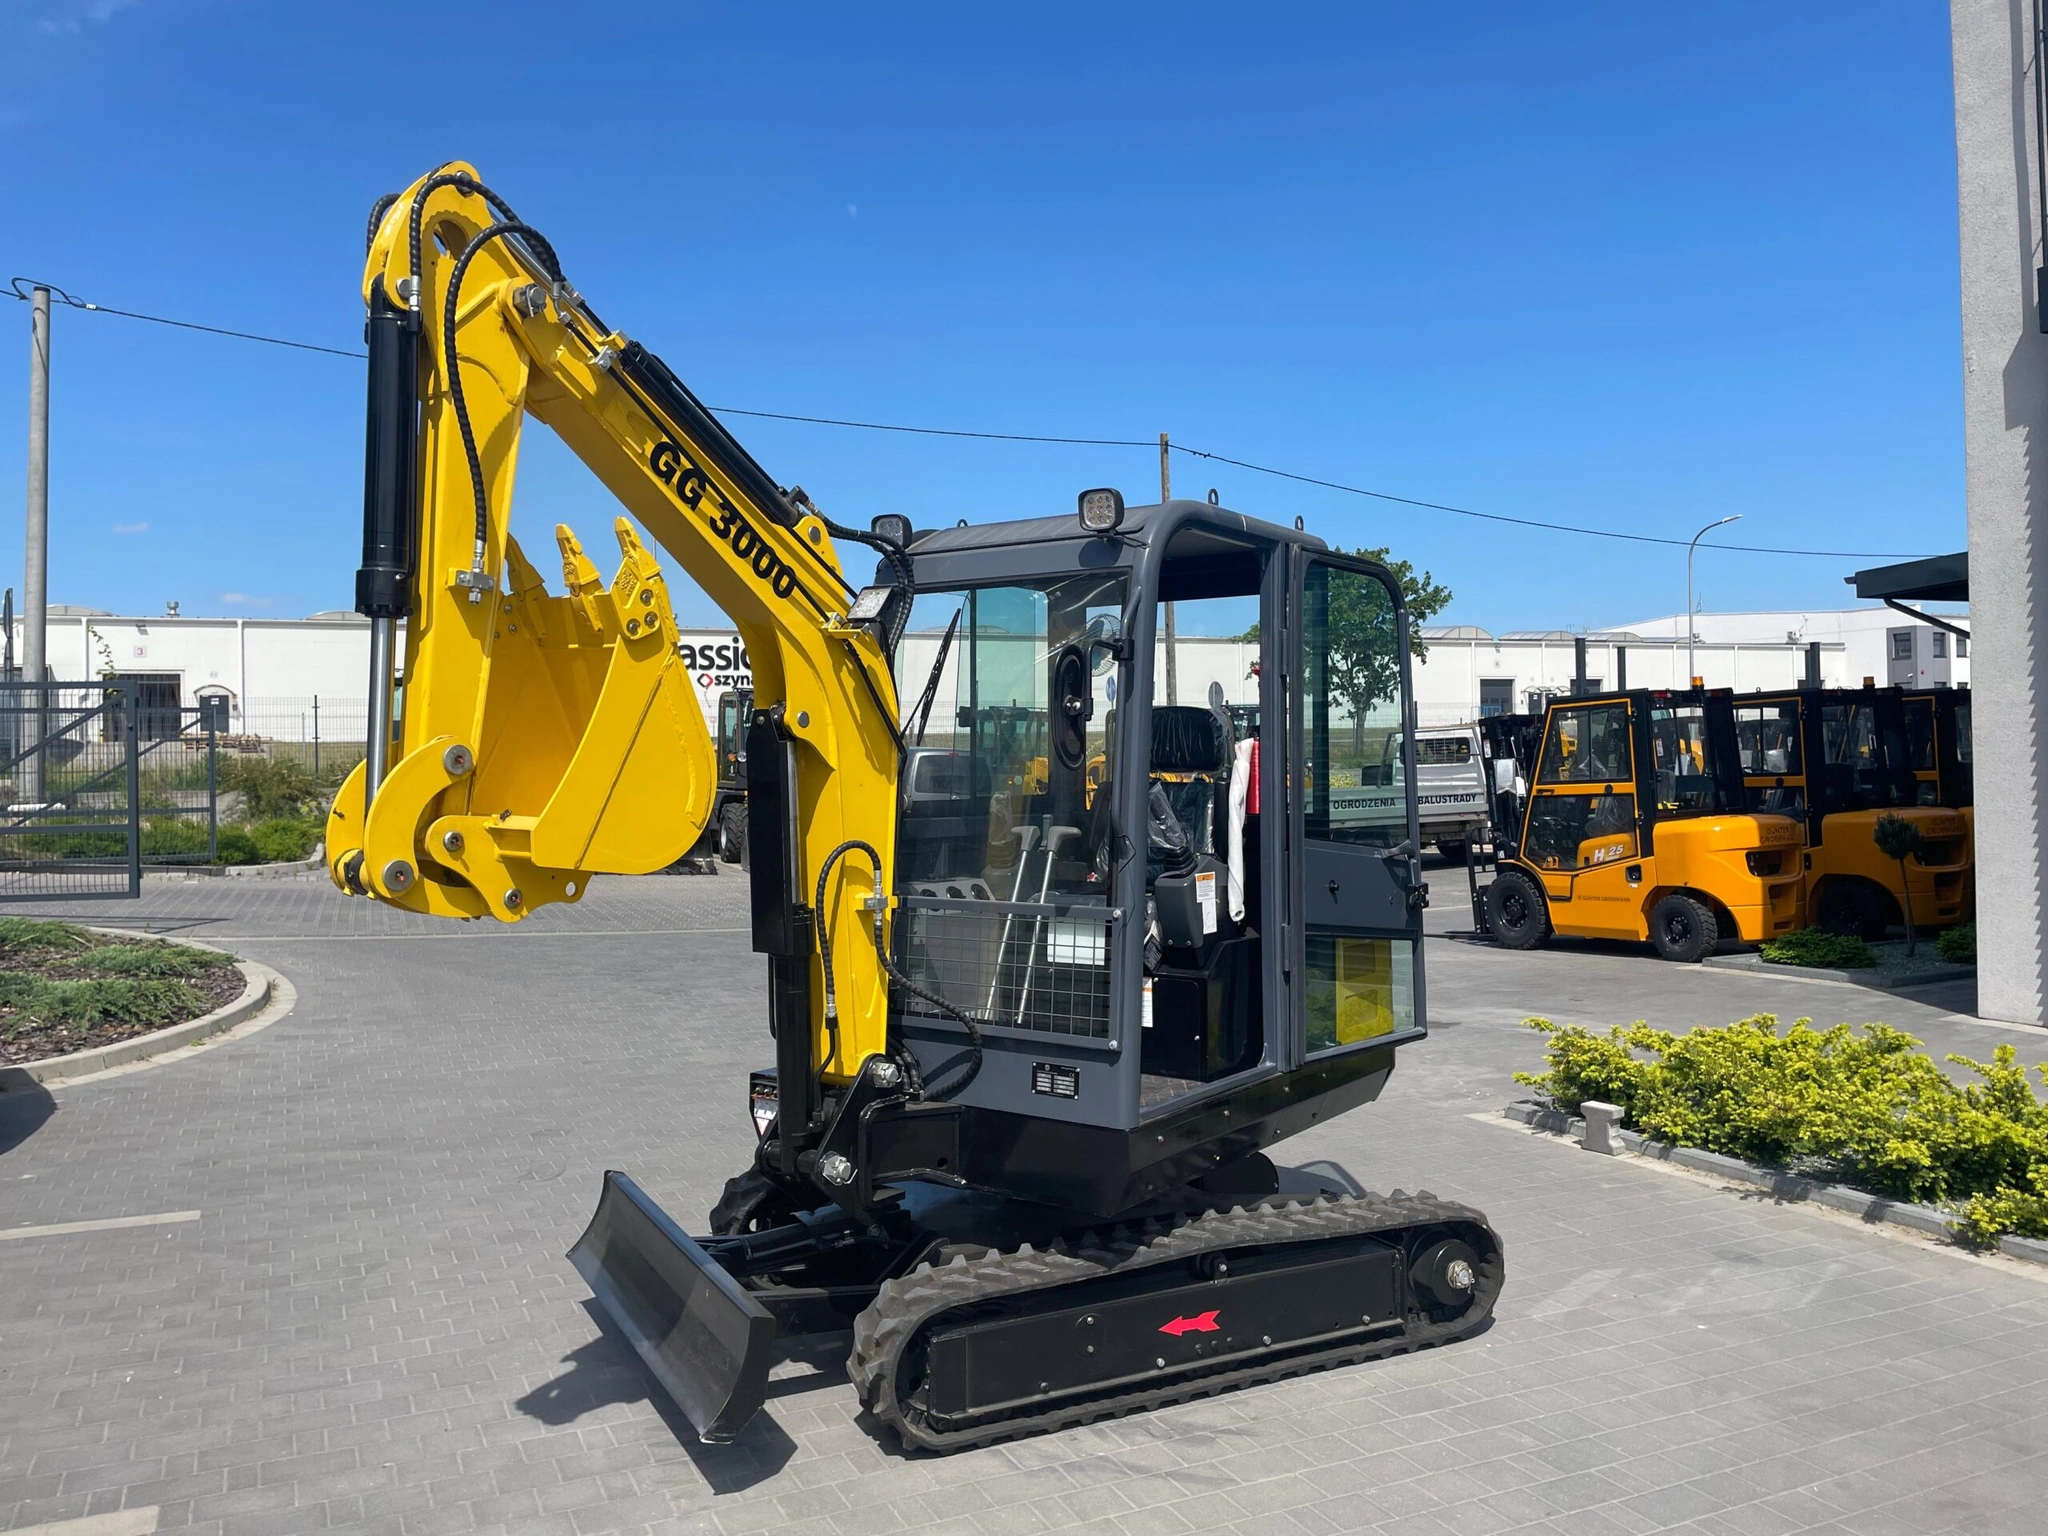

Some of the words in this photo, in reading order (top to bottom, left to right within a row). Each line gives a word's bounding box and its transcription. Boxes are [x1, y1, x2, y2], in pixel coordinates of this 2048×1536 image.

[650, 441, 707, 512] GG
[709, 502, 796, 598] 3000
[714, 674, 754, 689] szyn
[1333, 798, 1396, 809] OGRODZENIA
[1418, 794, 1477, 805] BALUSTRADY
[1594, 848, 1605, 862] H
[1608, 845, 1624, 856] 25
